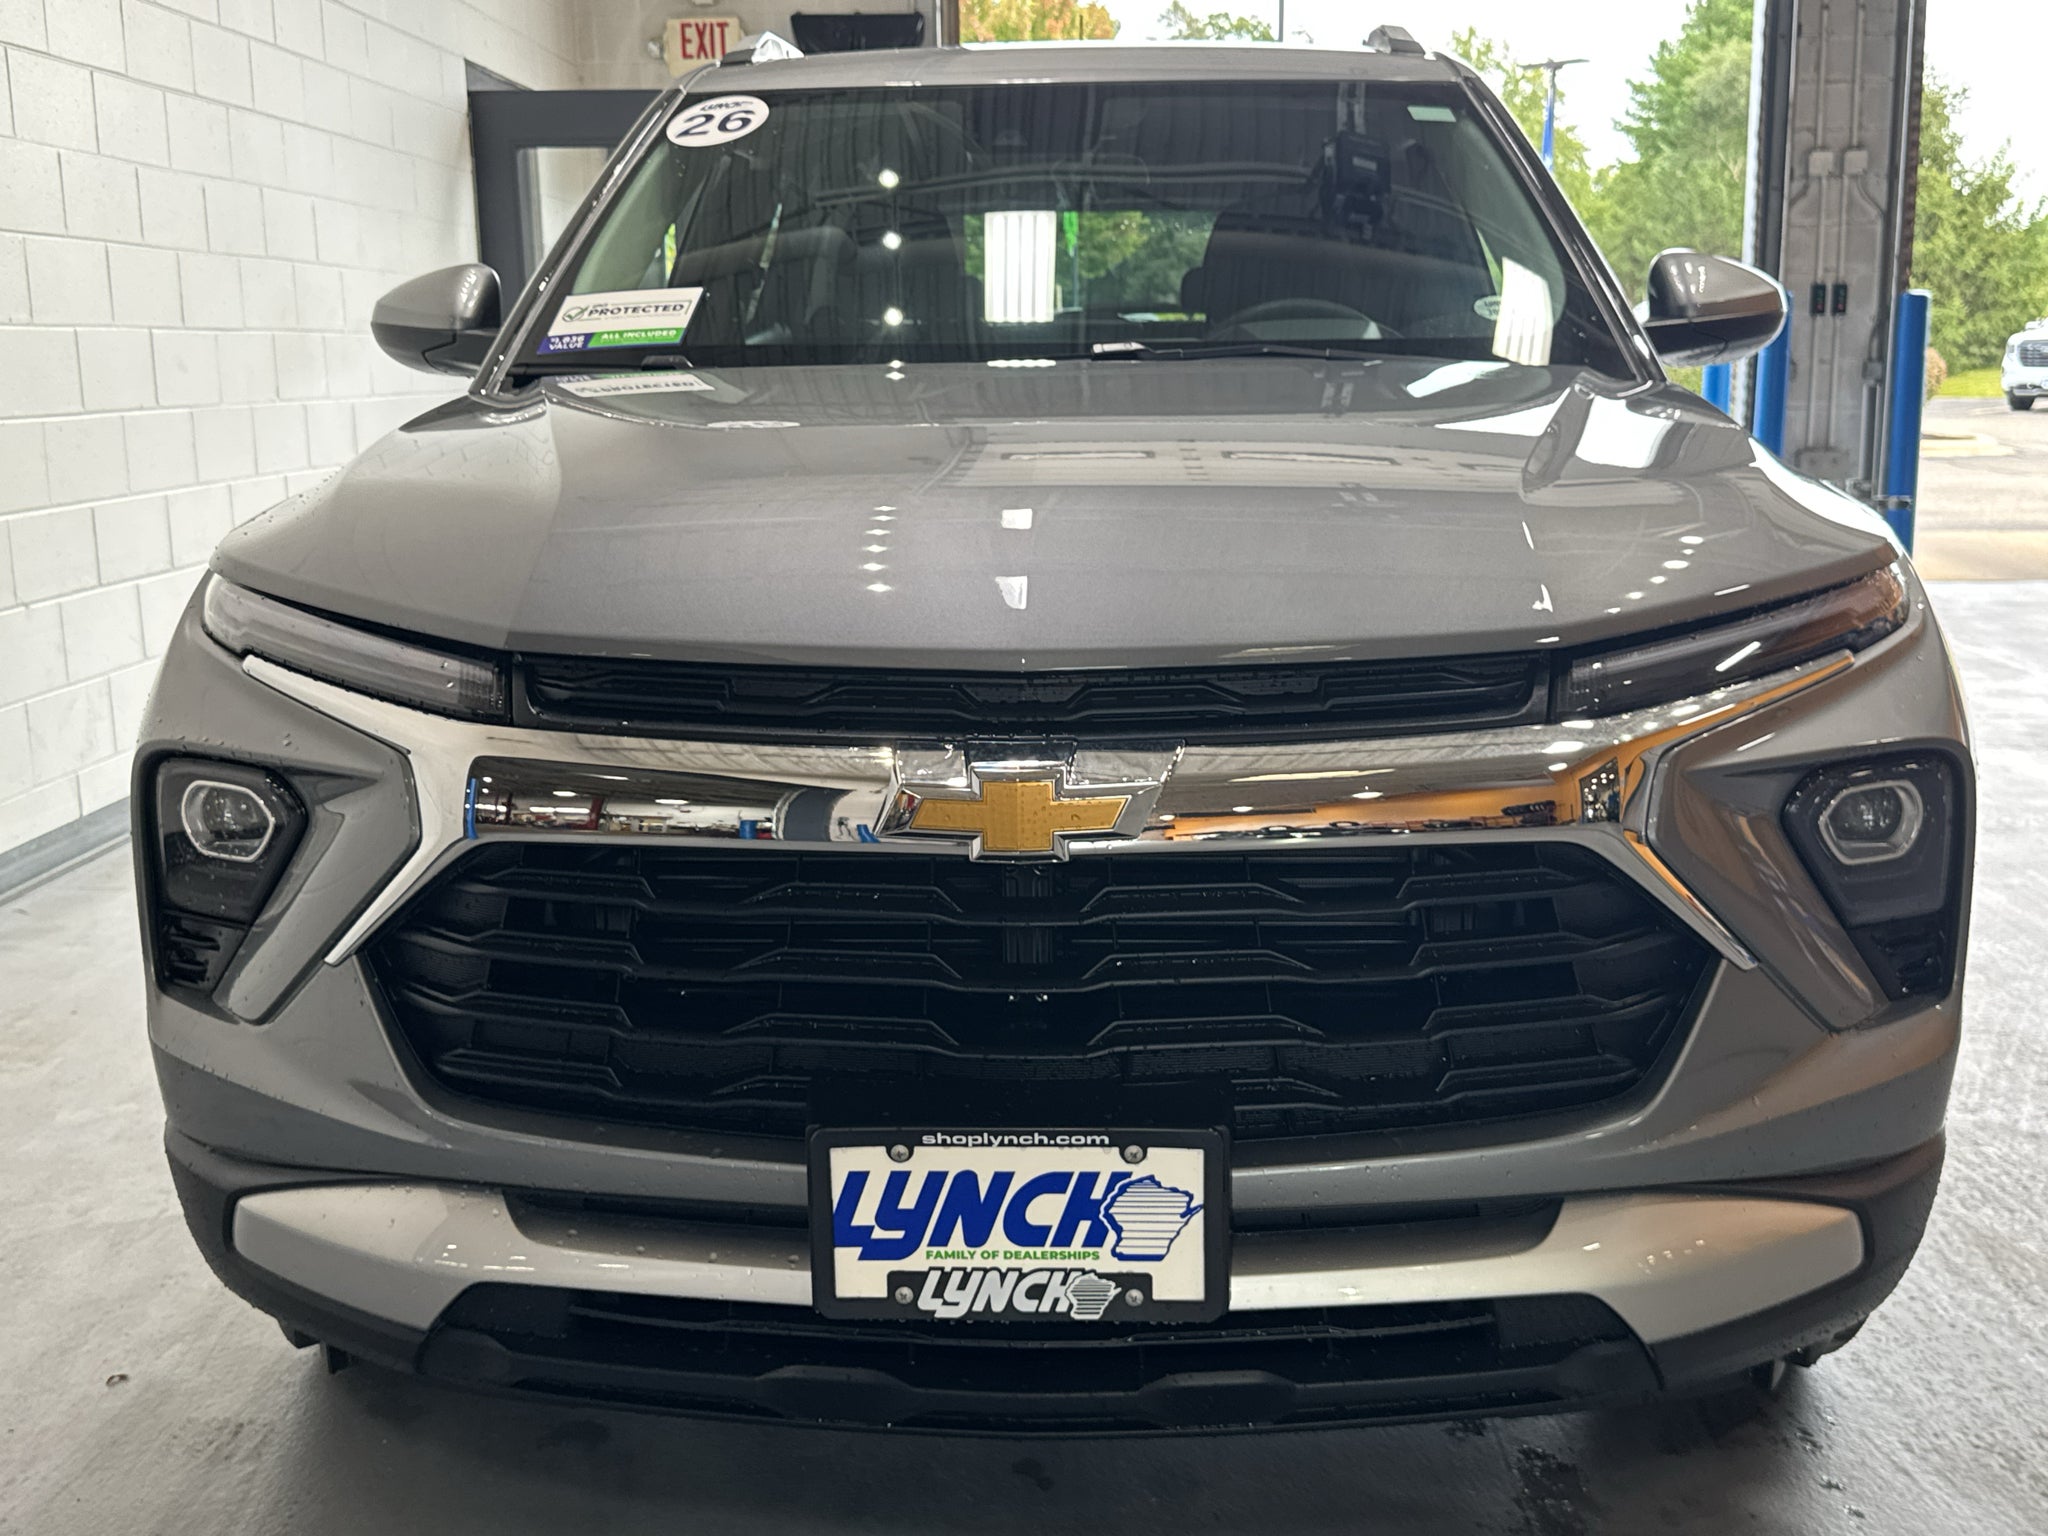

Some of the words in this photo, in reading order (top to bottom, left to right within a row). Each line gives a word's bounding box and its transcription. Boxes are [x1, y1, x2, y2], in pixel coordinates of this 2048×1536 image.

[680, 22, 729, 59] EXIT
[675, 110, 756, 138] 26
[588, 304, 684, 317] PROTECTED
[601, 332, 620, 341] ALL
[623, 329, 677, 339] INCLUDED
[549, 341, 584, 350] VALUE
[922, 1133, 1110, 1147] shoplynch.com
[833, 1169, 1133, 1261] LYNCH
[926, 1250, 976, 1260] FAMILY
[980, 1250, 1000, 1260] OF
[1003, 1250, 1100, 1260] DEALERSHIPS
[918, 1268, 1074, 1320] LYNCH
